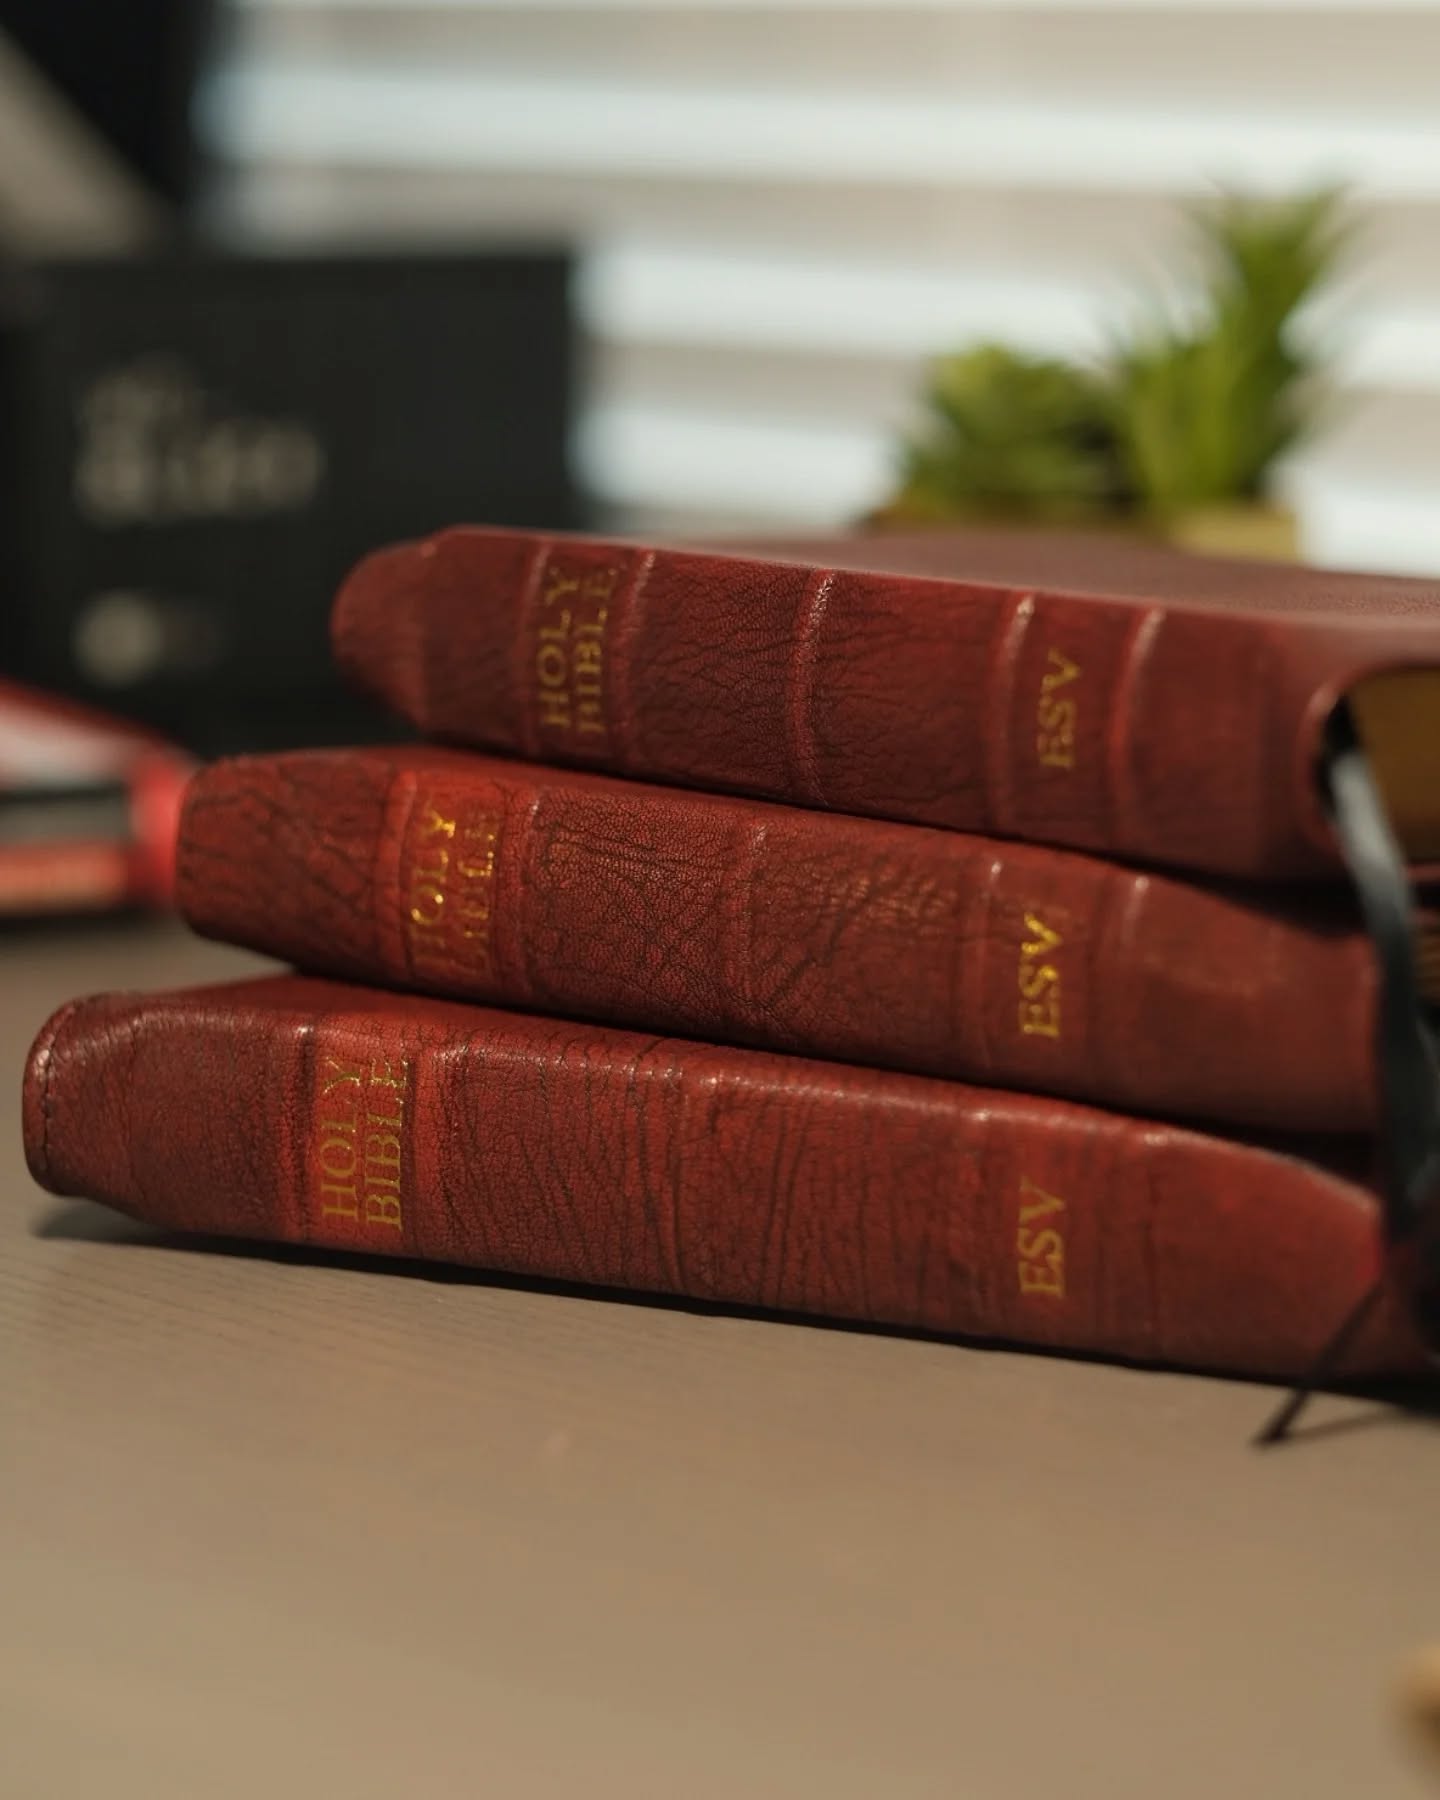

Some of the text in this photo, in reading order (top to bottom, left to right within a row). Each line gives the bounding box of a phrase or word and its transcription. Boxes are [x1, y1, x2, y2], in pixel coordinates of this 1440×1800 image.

[537, 567, 579, 728] HOLY
[1038, 648, 1081, 769] ESV
[1019, 911, 1062, 1037] ESV
[321, 1056, 361, 1221] HOLY
[366, 1053, 408, 1231] BIBLE
[1017, 1175, 1066, 1298] ESV
